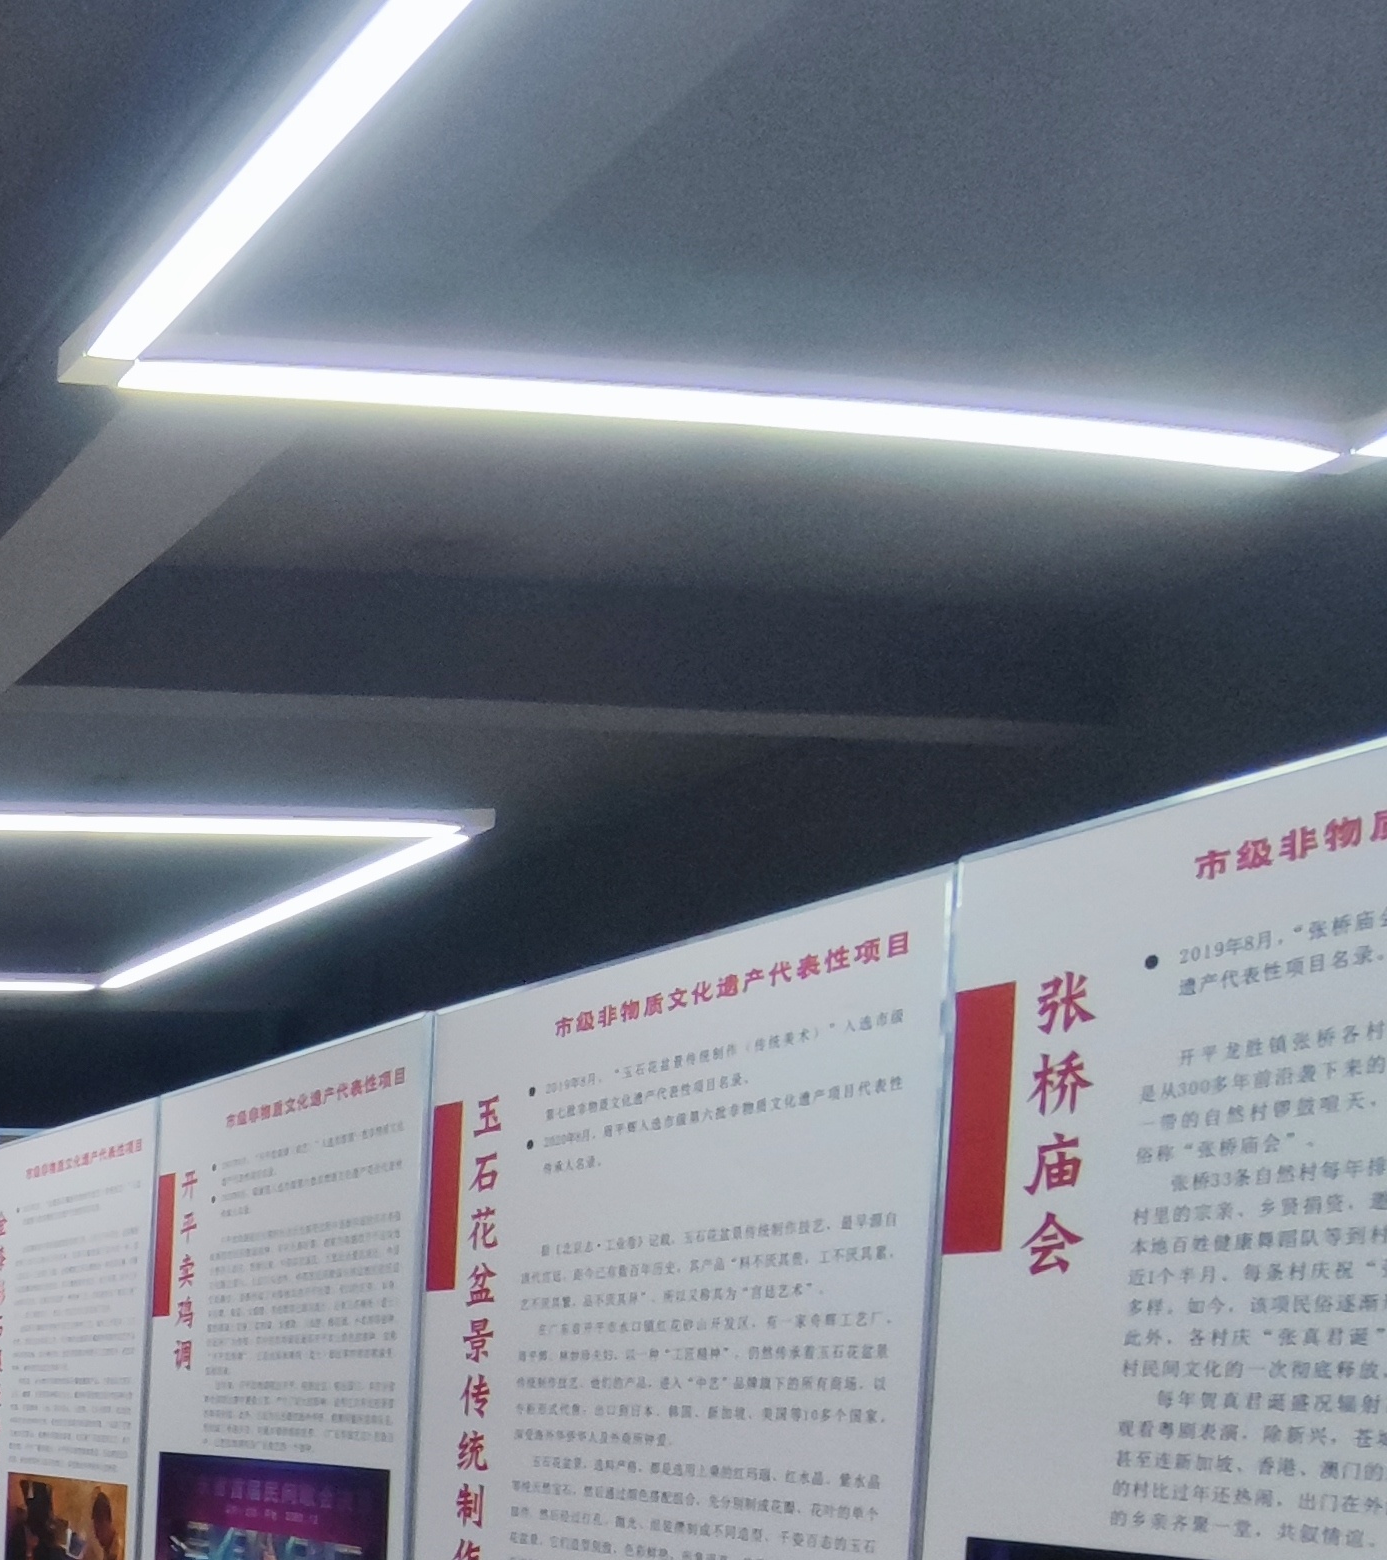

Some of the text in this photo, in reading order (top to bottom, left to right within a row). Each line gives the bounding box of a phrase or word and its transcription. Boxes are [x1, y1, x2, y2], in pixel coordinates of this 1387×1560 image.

[554, 931, 911, 1038] 市级非物质文化遗产代表性项目
[1020, 971, 1096, 1275] 张桥庙会
[173, 1170, 198, 1371] 开平卖鸡调
